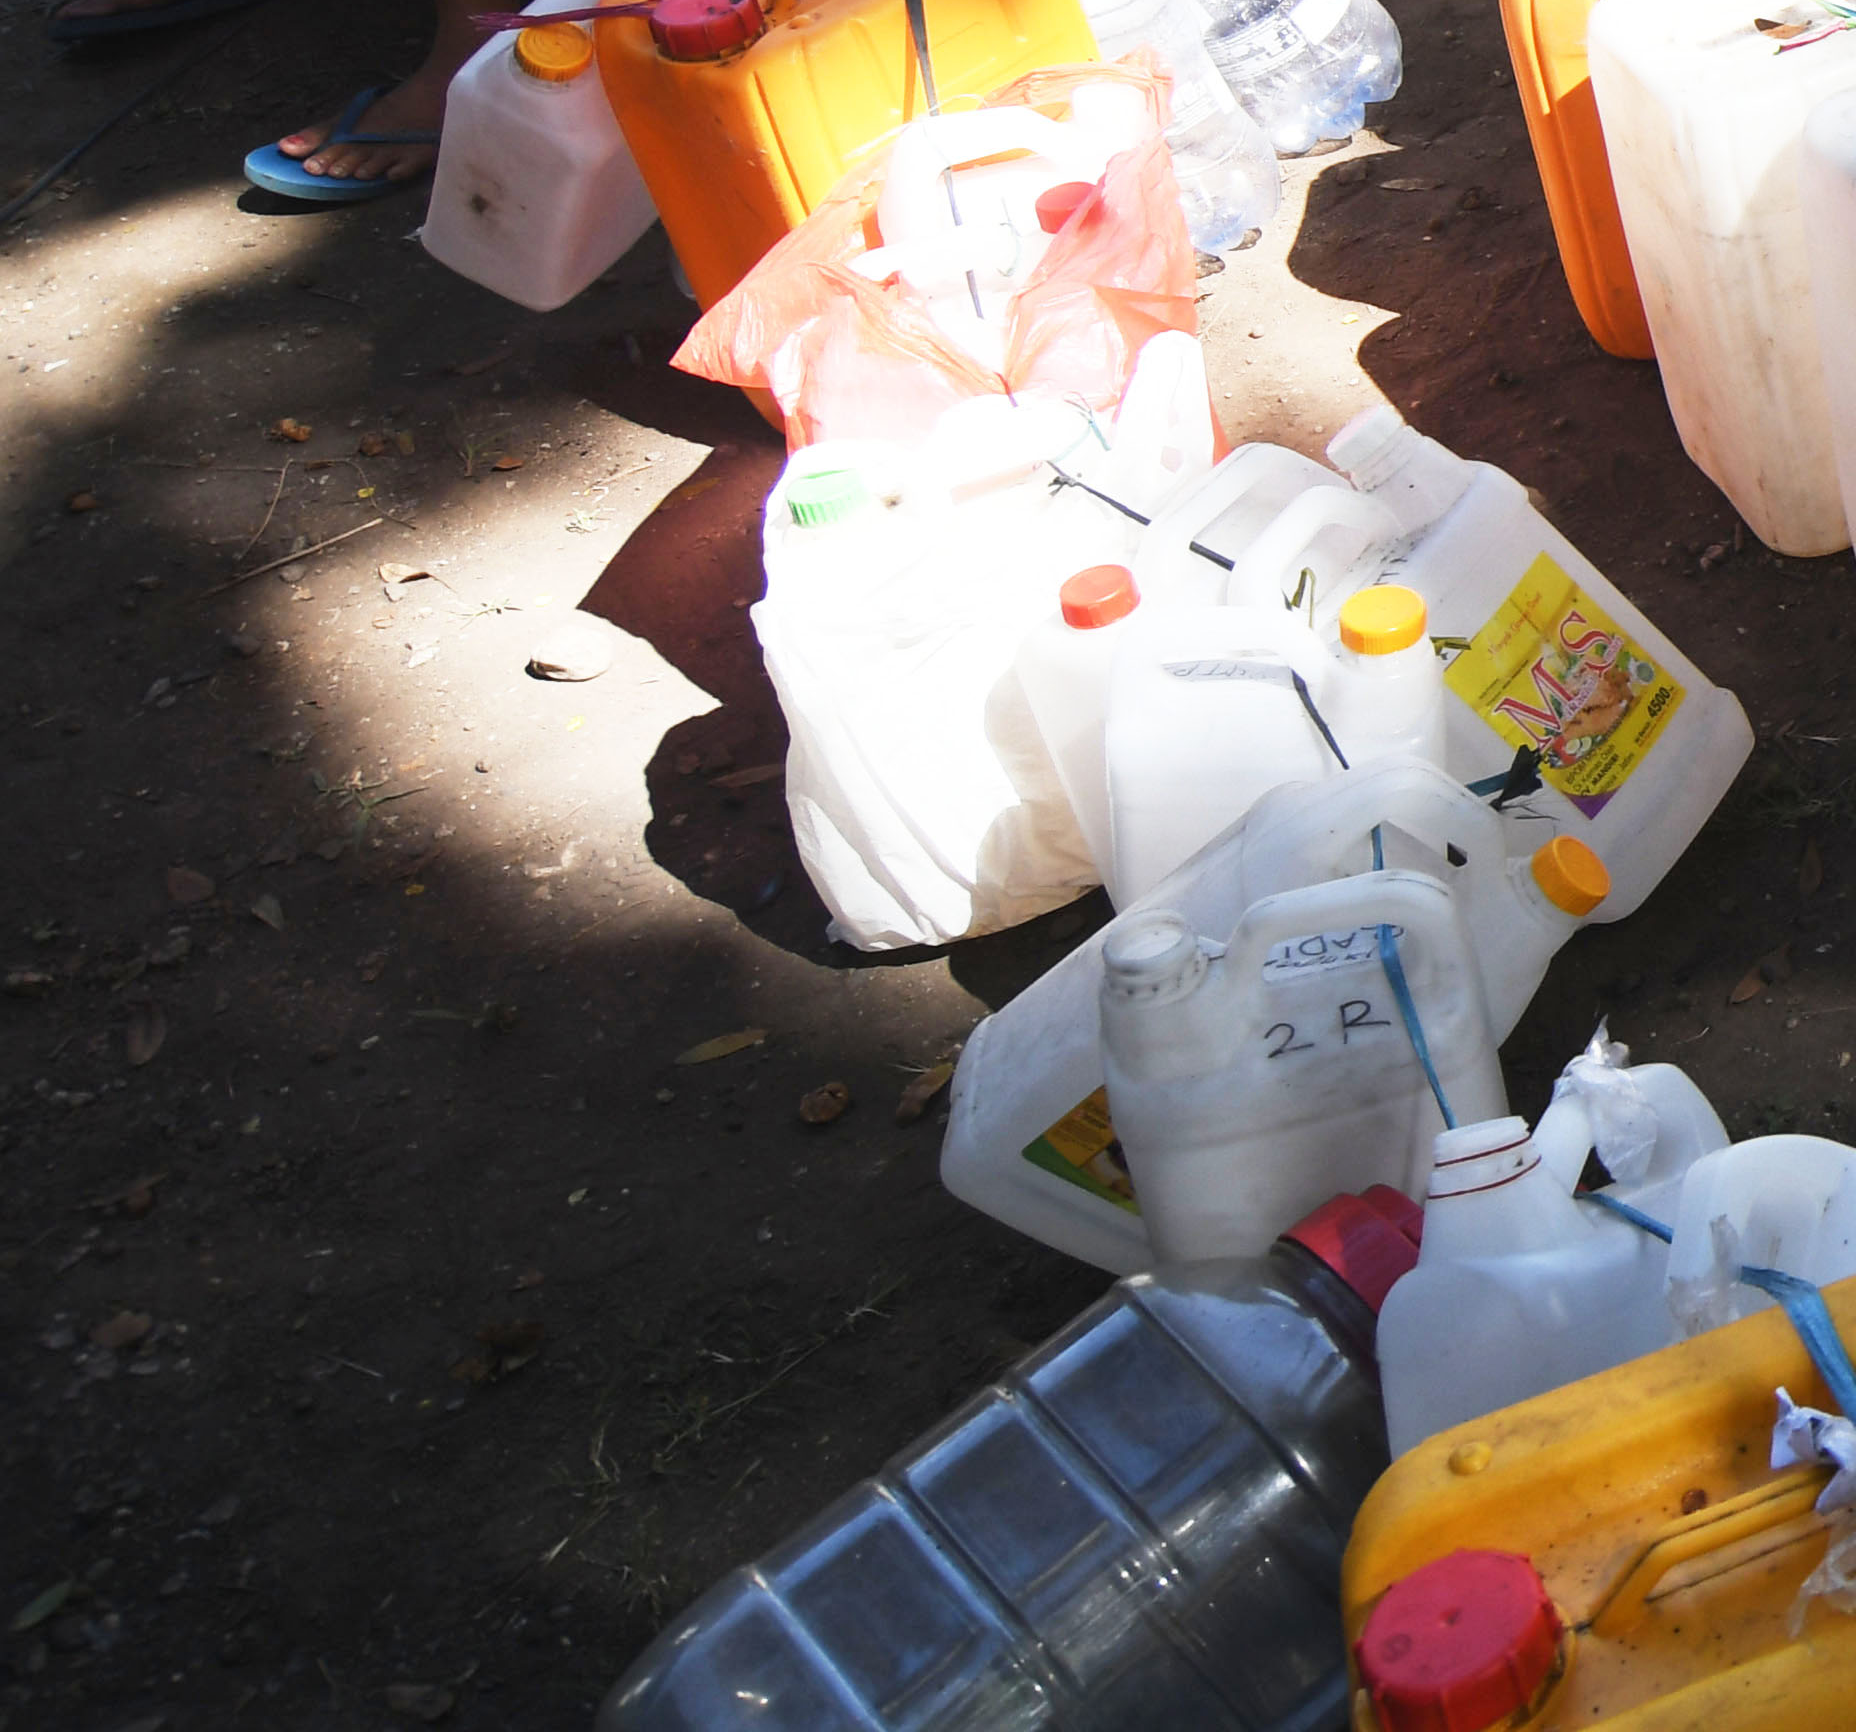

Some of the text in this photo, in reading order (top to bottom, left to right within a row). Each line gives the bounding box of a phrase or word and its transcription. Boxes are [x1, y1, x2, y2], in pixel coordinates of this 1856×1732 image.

[1645, 685, 1672, 720] 4500
[1264, 999, 1392, 1059] 2 R
